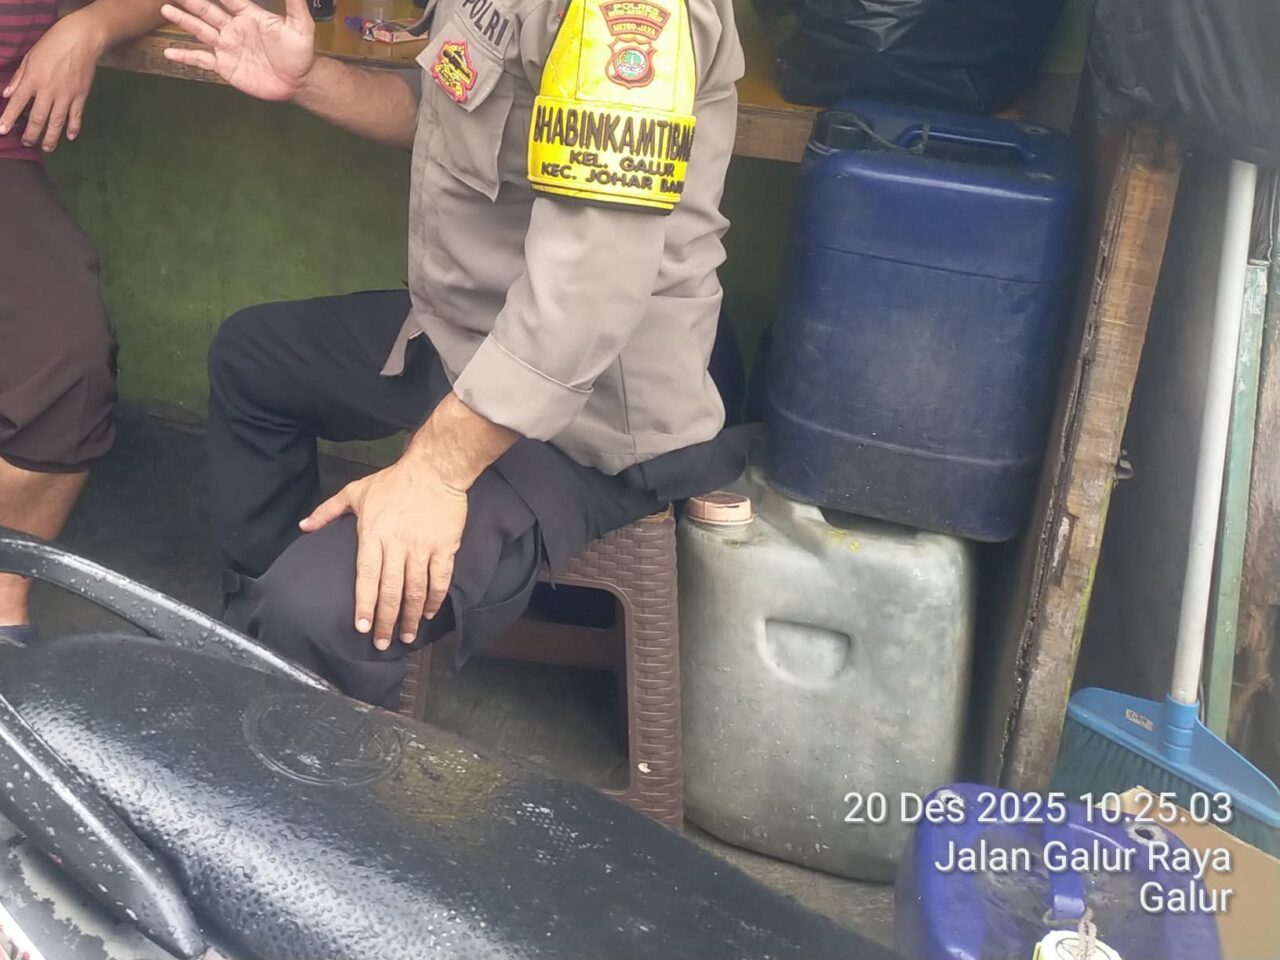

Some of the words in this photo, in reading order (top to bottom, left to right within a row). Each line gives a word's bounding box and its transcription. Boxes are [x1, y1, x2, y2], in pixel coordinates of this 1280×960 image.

[541, 162, 577, 180] KEC.
[586, 170, 652, 190] JOHAR
[570, 150, 608, 169] KEL.
[620, 157, 675, 177] GALUR
